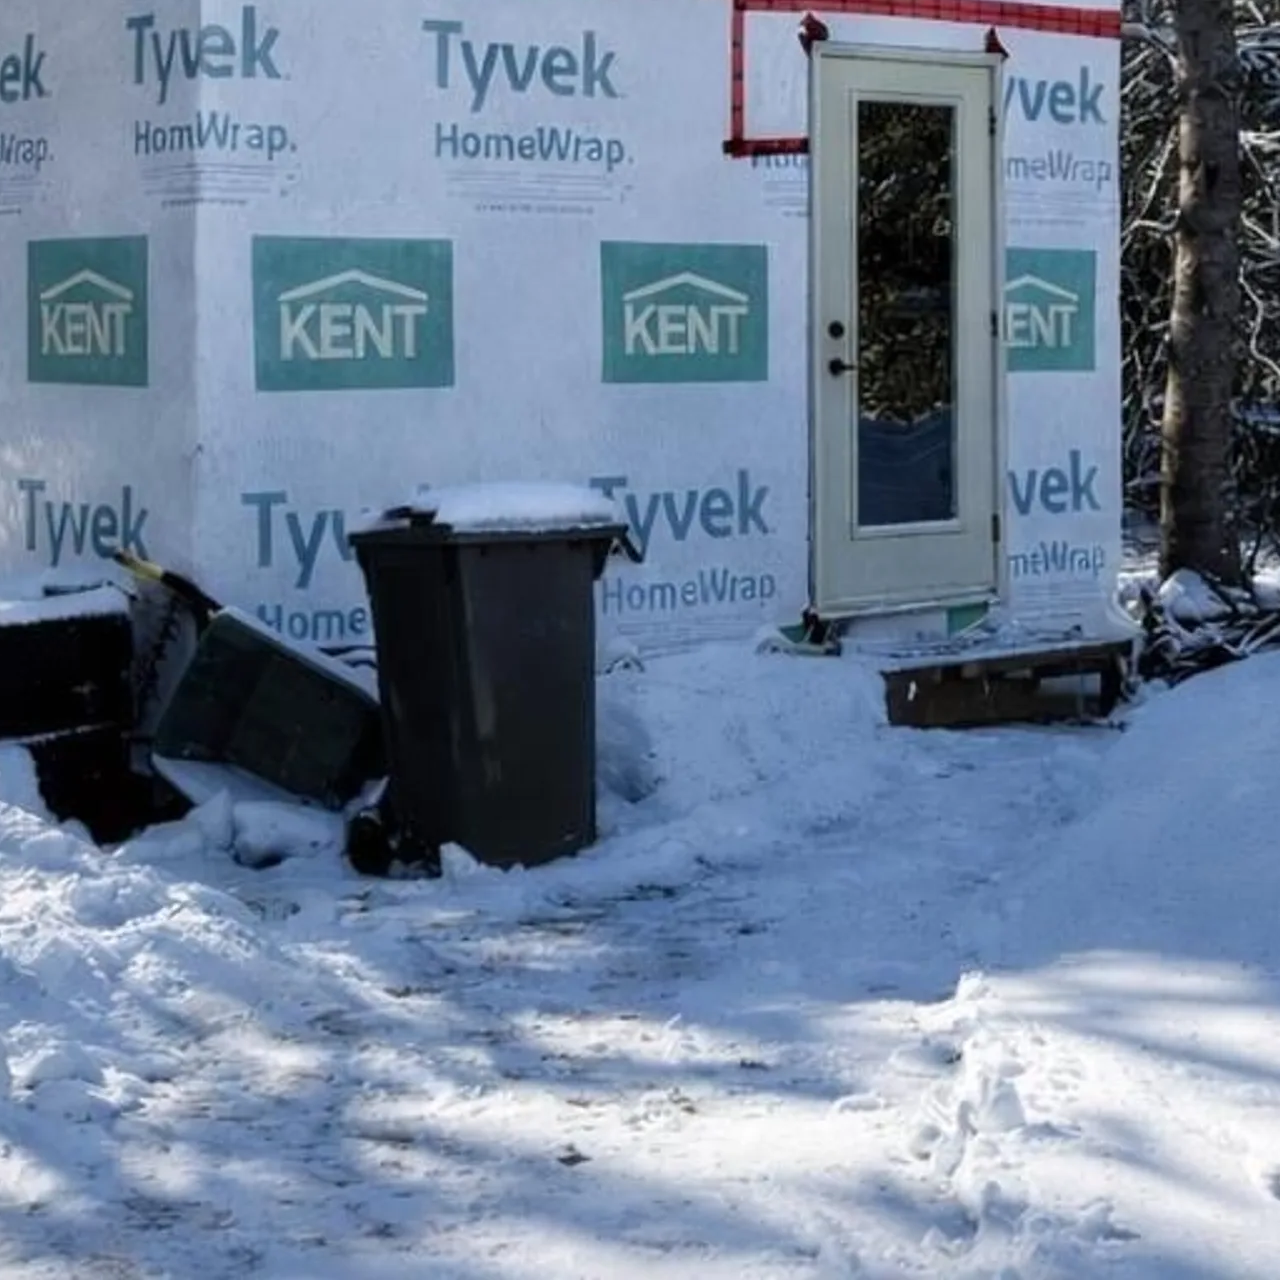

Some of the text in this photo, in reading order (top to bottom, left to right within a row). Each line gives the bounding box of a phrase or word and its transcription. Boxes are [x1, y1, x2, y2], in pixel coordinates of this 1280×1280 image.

[125, 5, 283, 106] Tyvek
[421, 19, 624, 114] Tyvek
[39, 301, 134, 357] KENT
[278, 303, 428, 360] KENT
[623, 303, 749, 355] KENT
[19, 478, 150, 567] Tyvek
